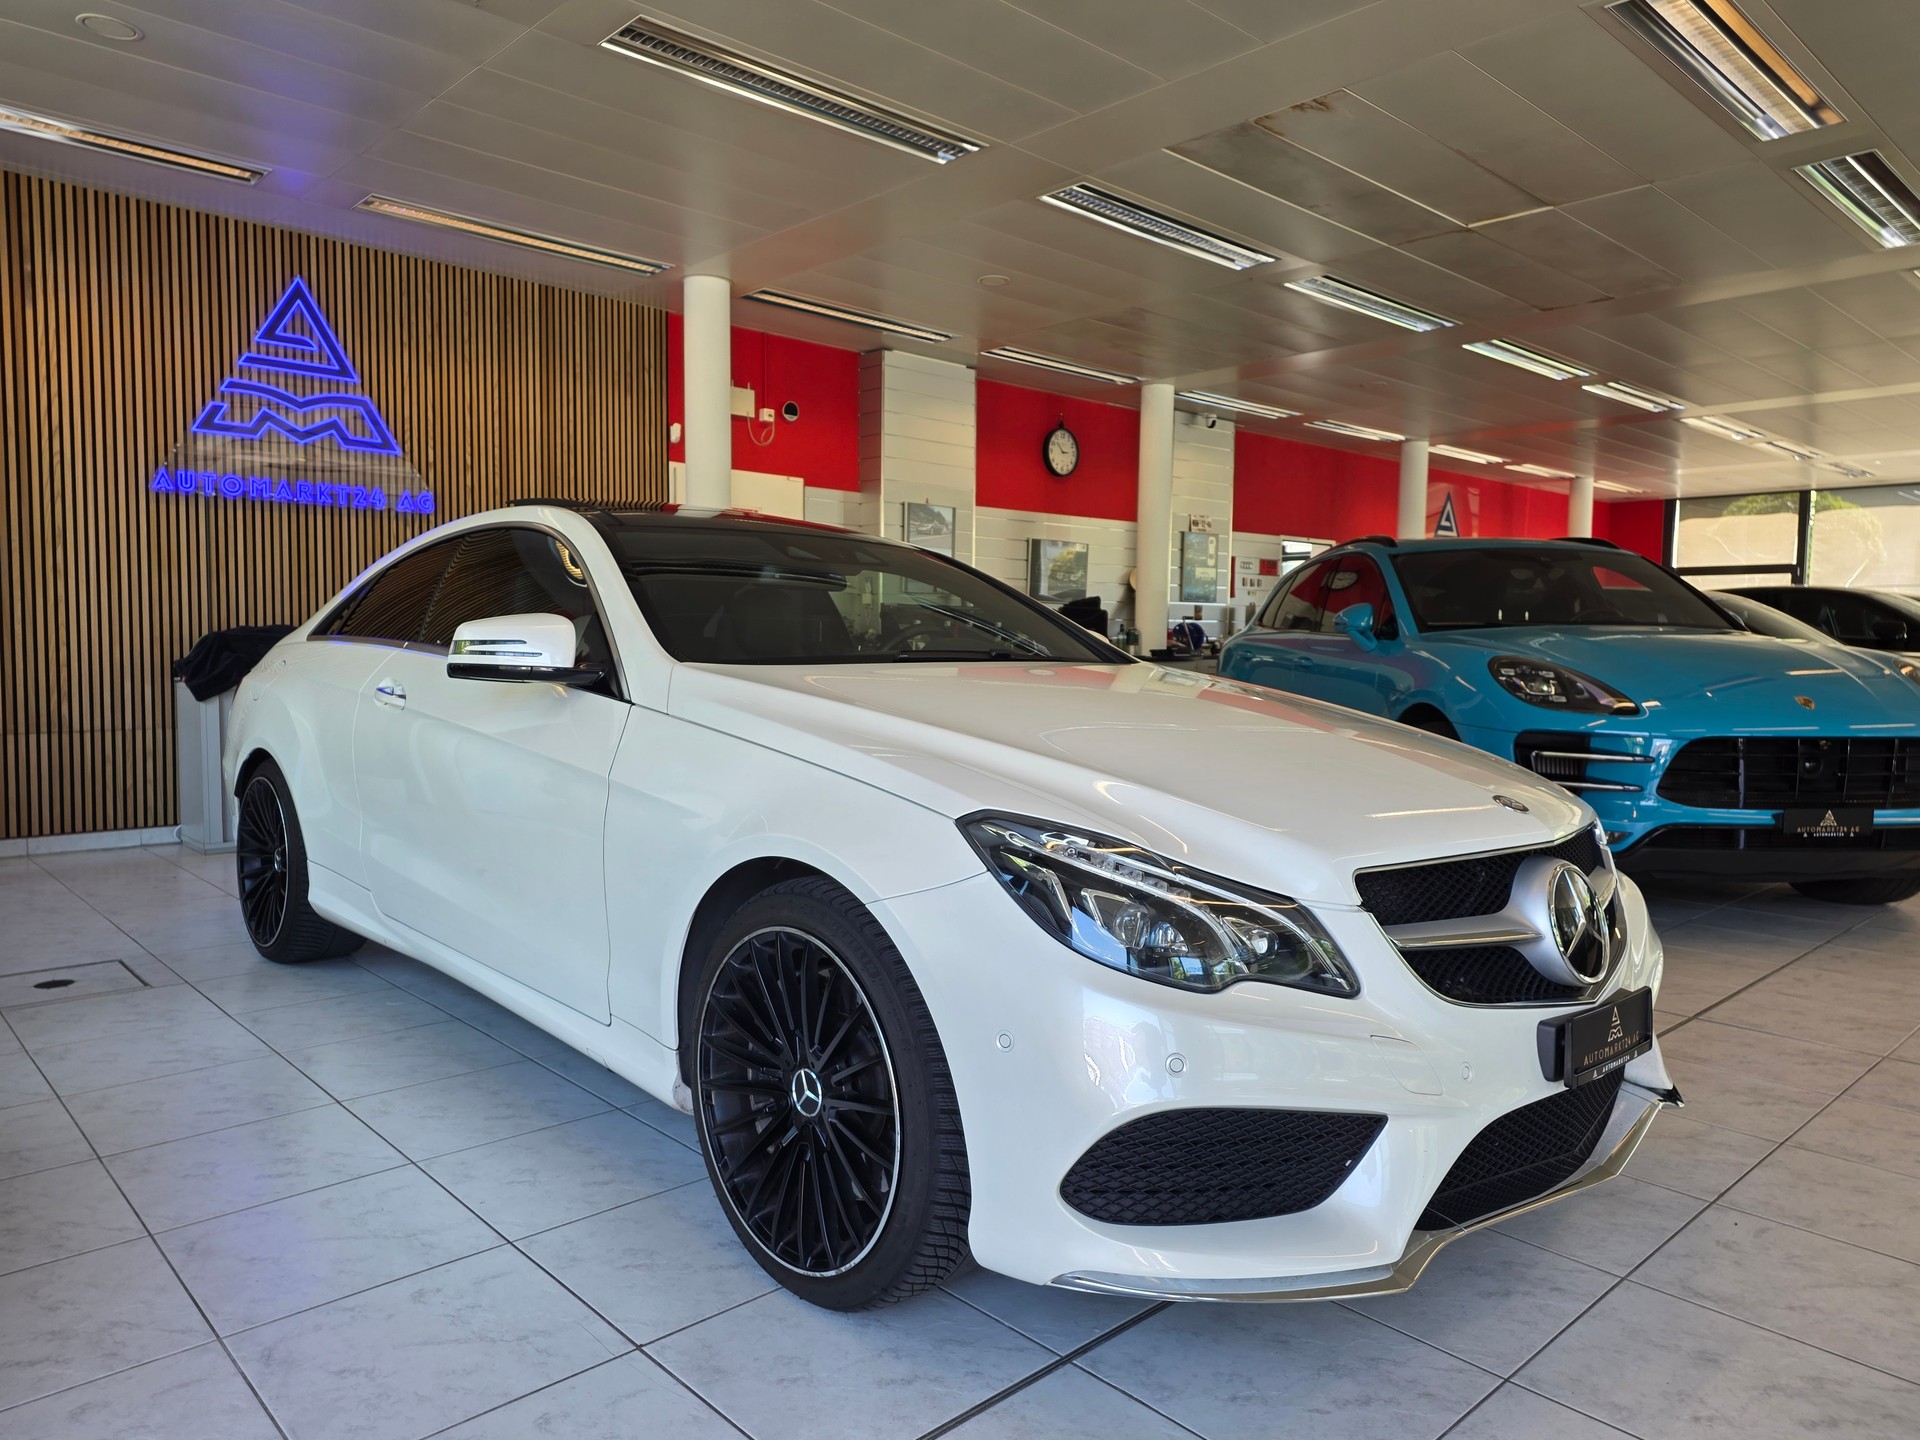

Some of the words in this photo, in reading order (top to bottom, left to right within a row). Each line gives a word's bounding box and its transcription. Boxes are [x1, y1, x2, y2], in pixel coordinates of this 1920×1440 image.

[150, 466, 386, 510] AUTOMARKT24
[395, 489, 435, 515] AG
[1583, 1035, 1631, 1066] AUTOMARKT24
[1632, 1030, 1640, 1043] AG
